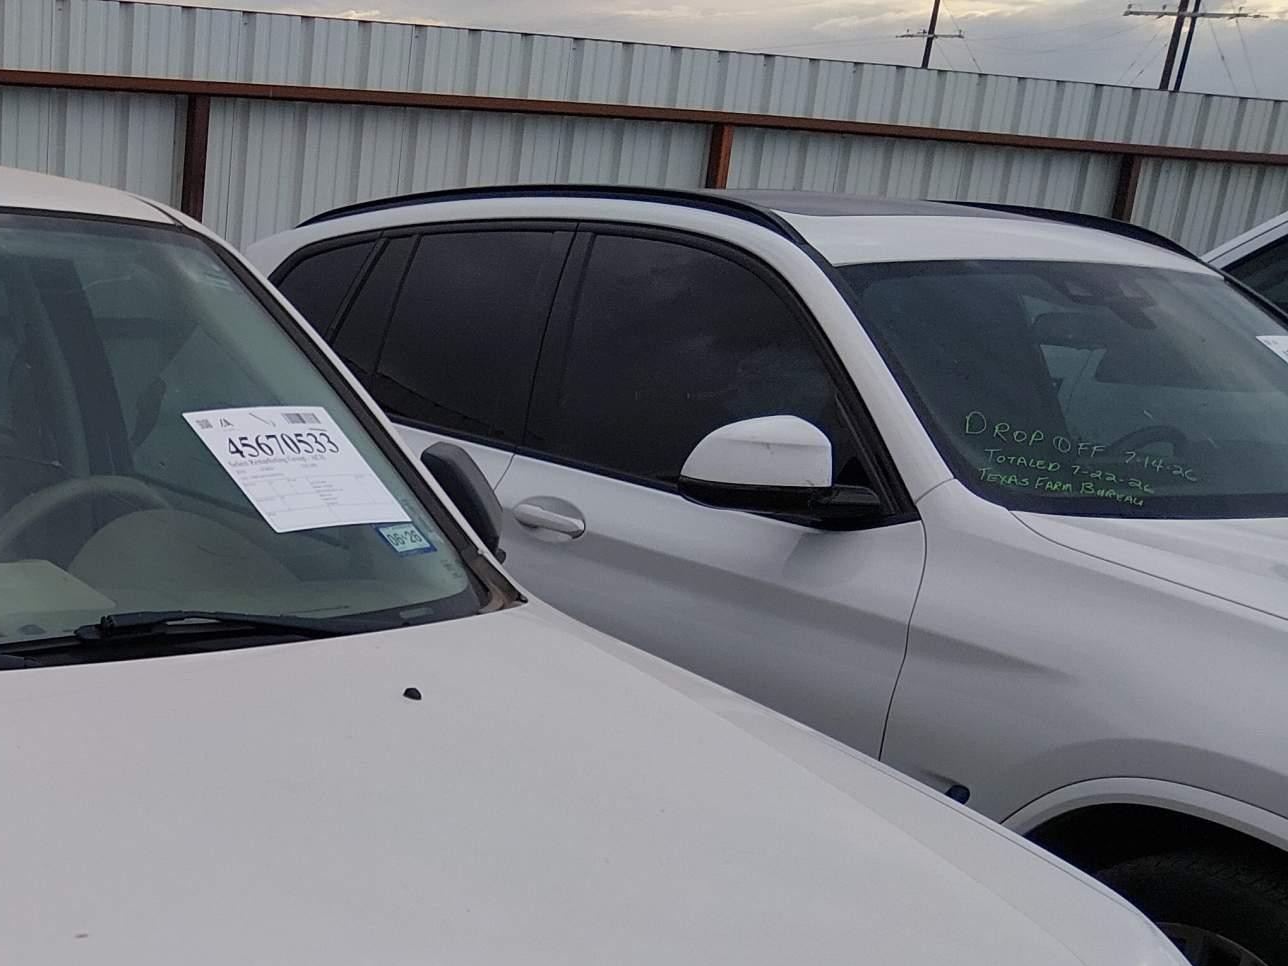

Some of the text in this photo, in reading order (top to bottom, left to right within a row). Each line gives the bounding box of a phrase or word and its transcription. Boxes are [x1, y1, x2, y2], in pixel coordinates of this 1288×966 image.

[227, 432, 340, 459] 45670533
[965, 411, 1044, 447] DROP
[1052, 436, 1106, 458] OFF
[984, 449, 1061, 472] TOTALED
[977, 467, 1145, 507] TEXAS FARM BUREAU
